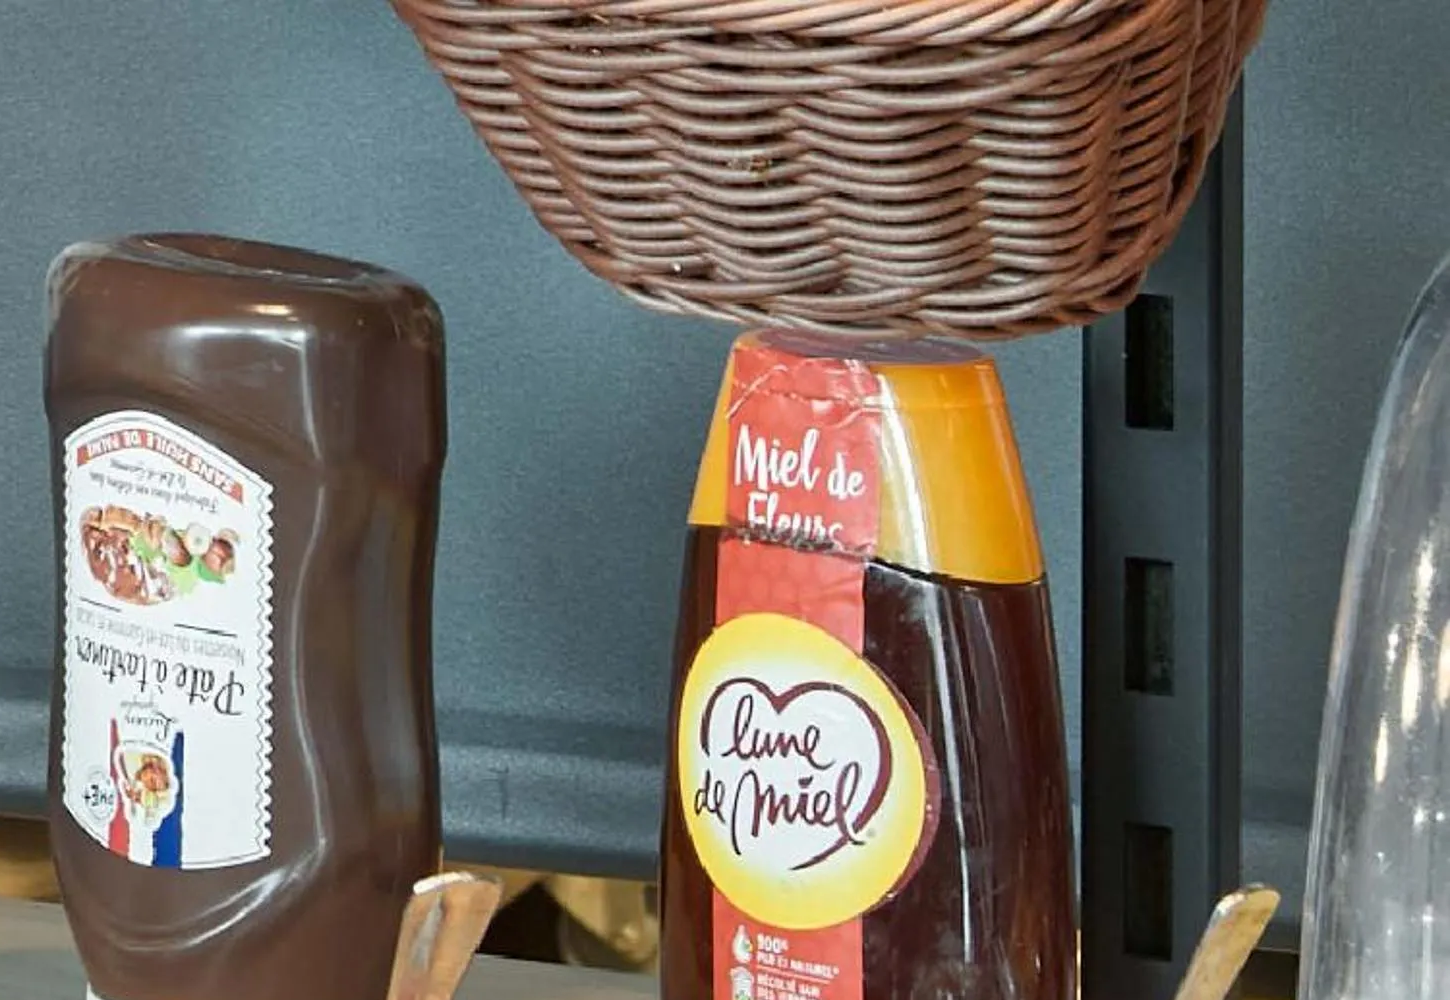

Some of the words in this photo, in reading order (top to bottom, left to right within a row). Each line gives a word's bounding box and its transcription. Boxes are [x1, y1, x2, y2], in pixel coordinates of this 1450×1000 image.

[191, 453, 235, 495] SANS
[735, 424, 820, 490] Miel
[827, 451, 866, 500] de
[75, 635, 147, 693] tartiner
[154, 659, 168, 695] à
[177, 662, 245, 717] Pâte
[722, 694, 835, 770] lune
[694, 769, 727, 825] de
